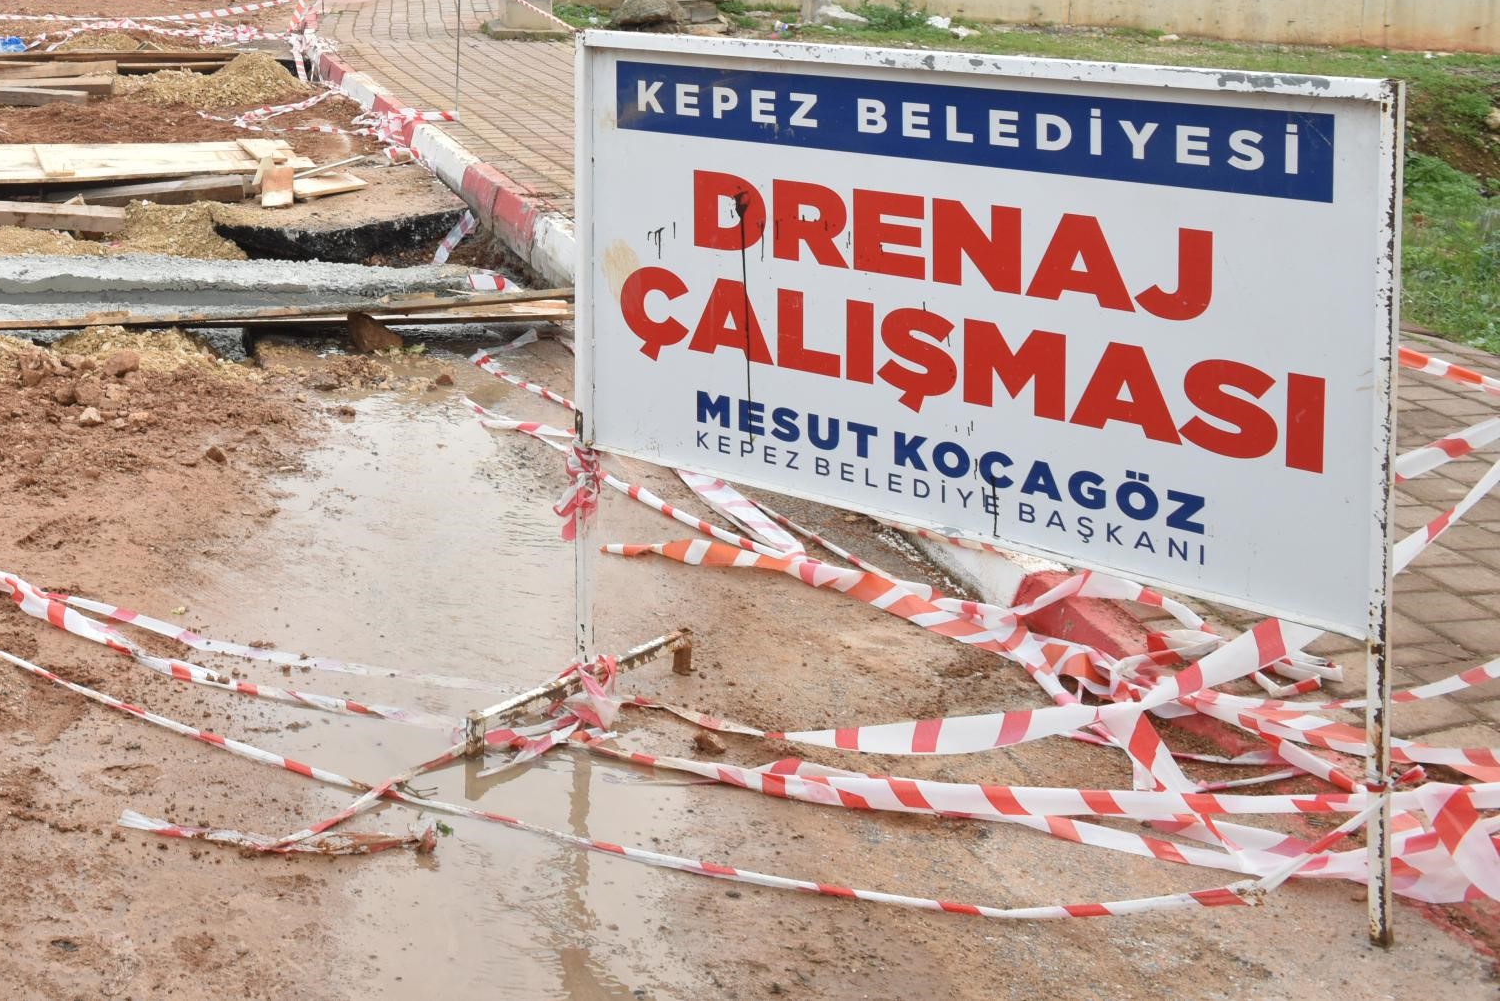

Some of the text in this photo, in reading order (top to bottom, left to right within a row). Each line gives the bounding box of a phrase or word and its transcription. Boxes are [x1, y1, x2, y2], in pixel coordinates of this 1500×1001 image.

[636, 79, 1301, 175] KEPEZ BELEDİYESİ
[693, 169, 1214, 322] DRENAJ
[619, 265, 1326, 475] ÇALIŞMASI
[695, 430, 1208, 566] KEPEZ BELEDİYE BAŞKANI
[696, 390, 1206, 535] MESUT KOCAGÖZ
